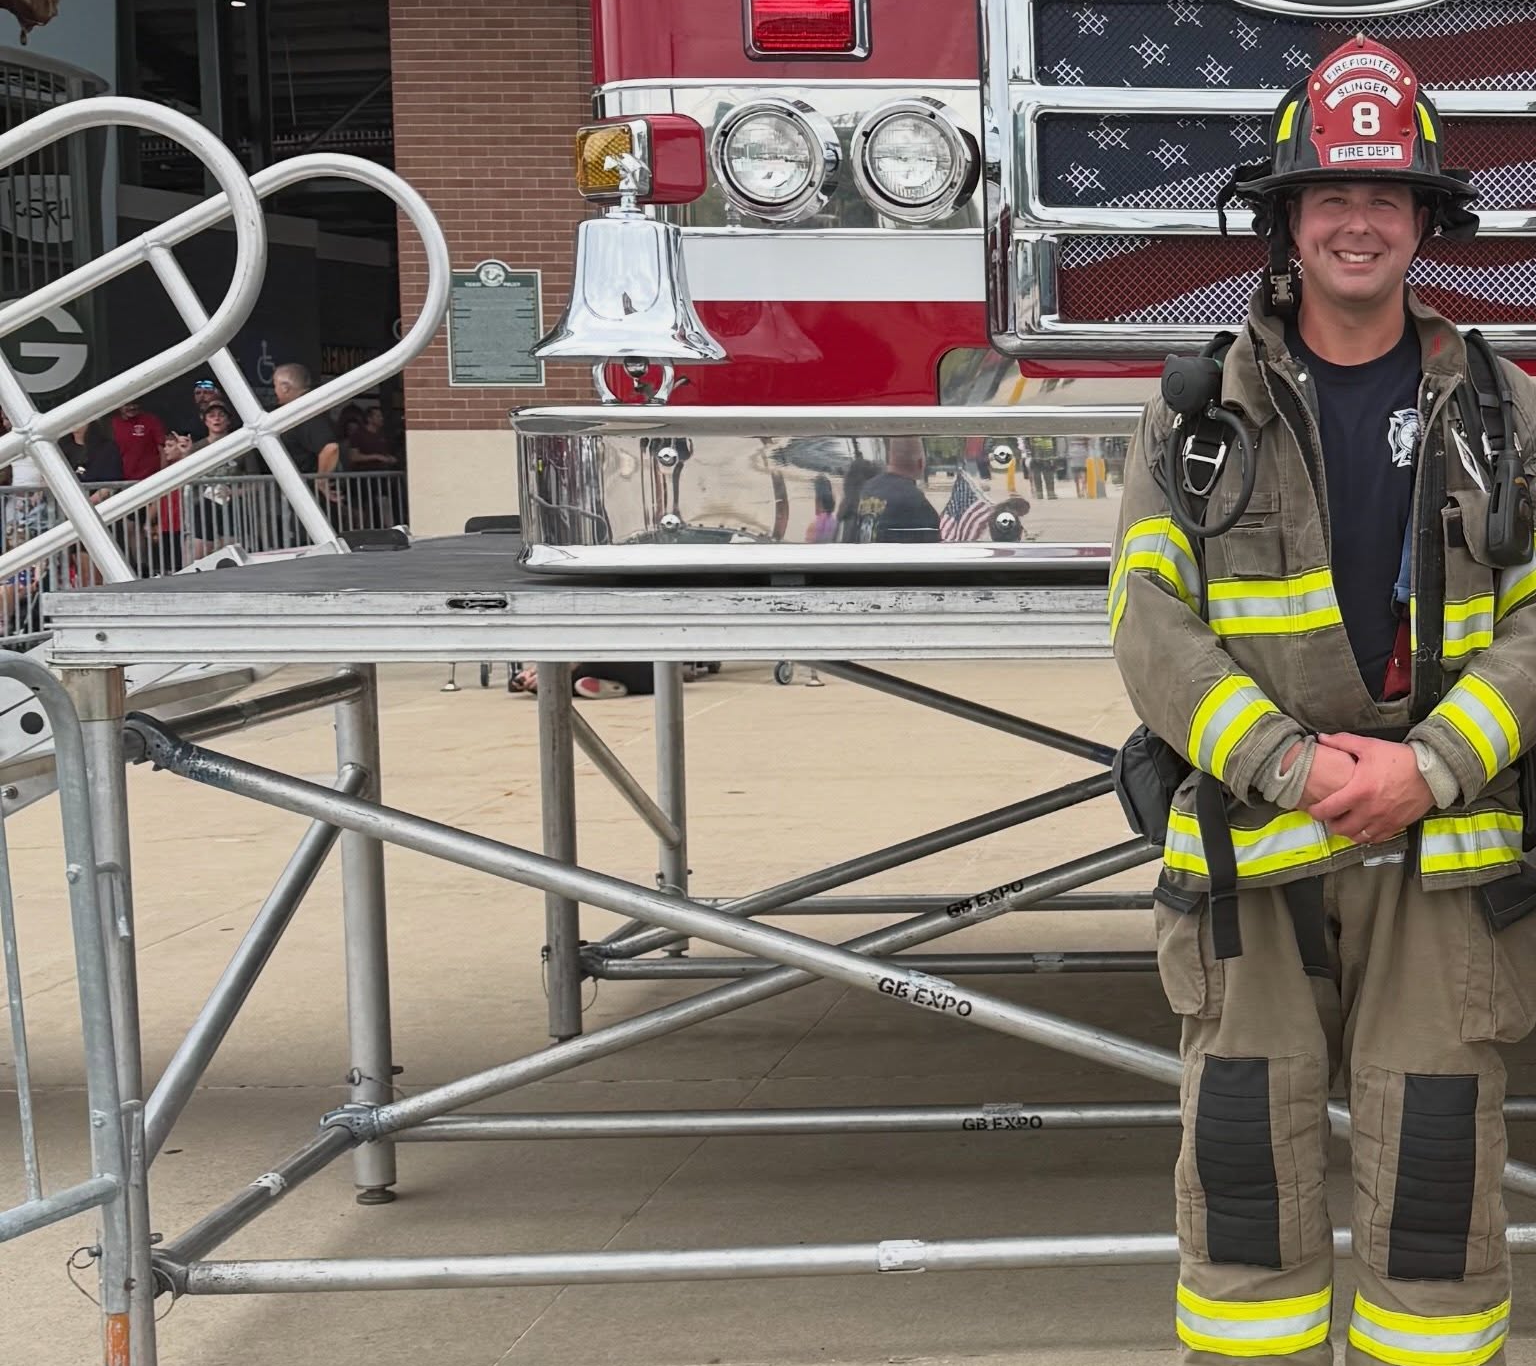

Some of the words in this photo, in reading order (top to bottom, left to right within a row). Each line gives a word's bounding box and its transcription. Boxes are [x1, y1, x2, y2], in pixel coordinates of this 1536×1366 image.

[1326, 57, 1398, 82] FIREFIGHTER
[1337, 80, 1389, 98] SLINGER
[1352, 100, 1380, 136] 8
[1336, 146, 1364, 158] FIRE
[1367, 145, 1396, 157] DEPT
[945, 899, 973, 919] GB
[976, 879, 1025, 909] EXPO
[877, 976, 909, 1000] GB
[913, 987, 973, 1018] EXPO
[962, 1116, 988, 1131] GB
[992, 1115, 1043, 1130] EXPO
